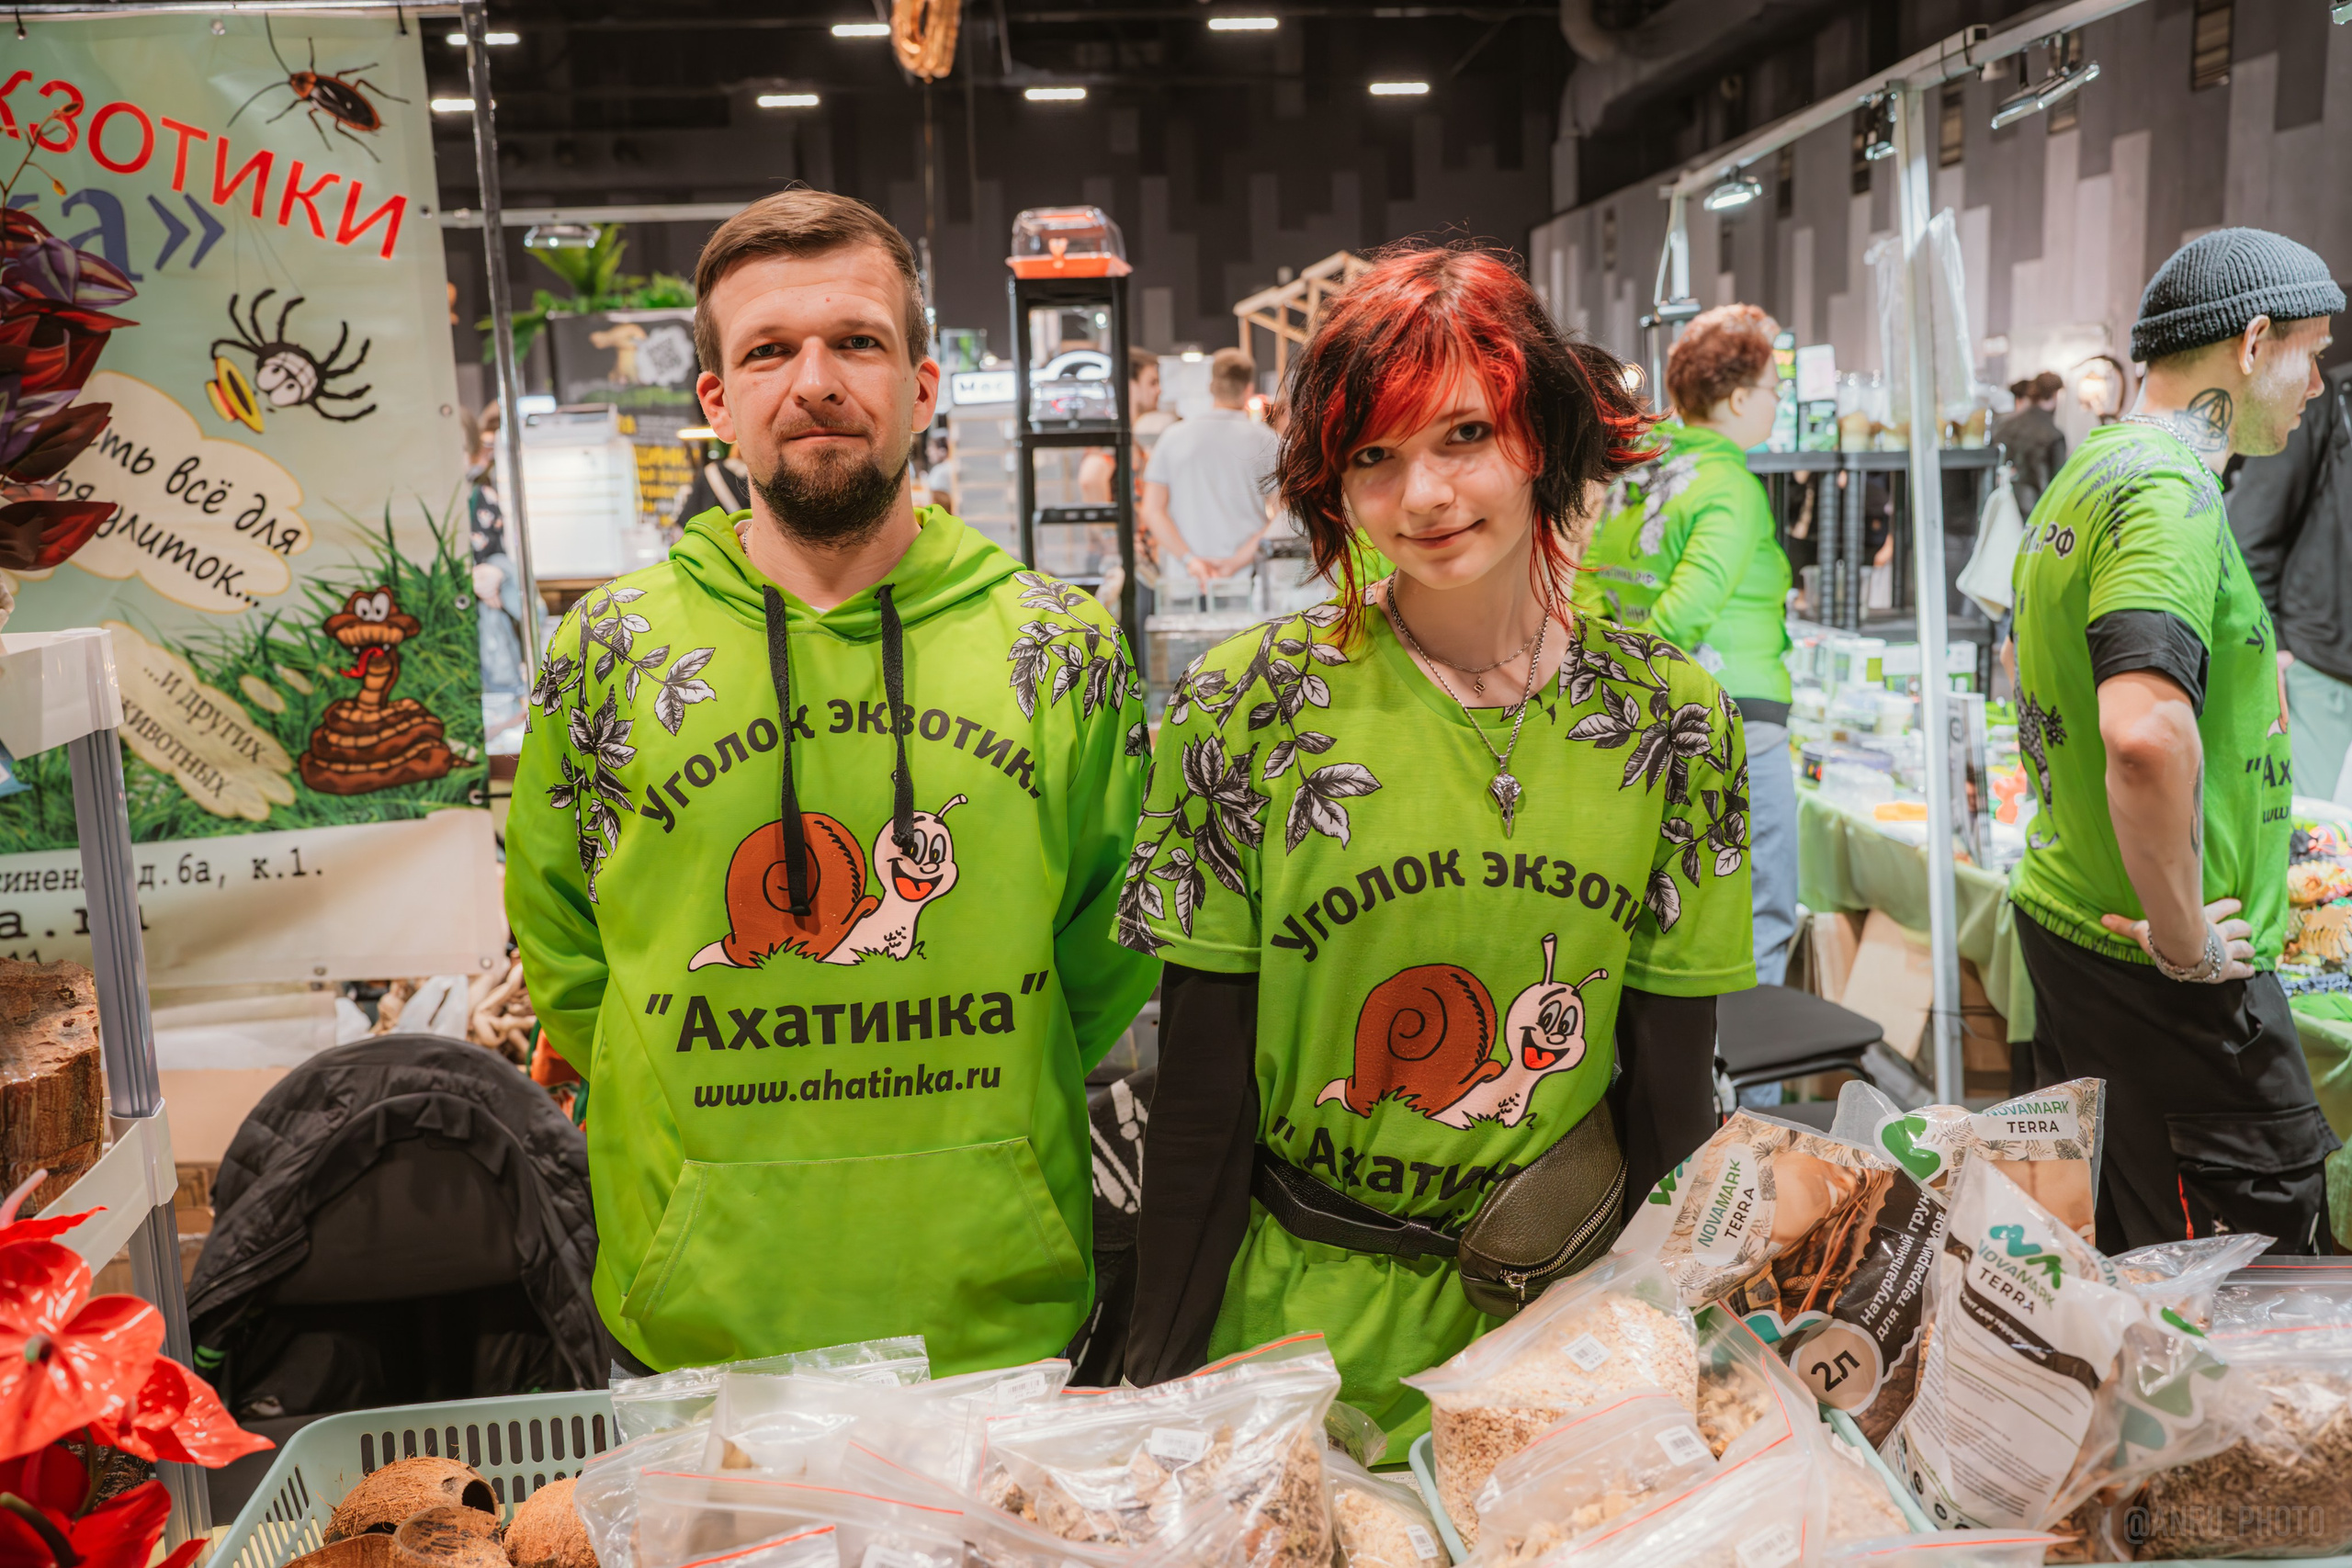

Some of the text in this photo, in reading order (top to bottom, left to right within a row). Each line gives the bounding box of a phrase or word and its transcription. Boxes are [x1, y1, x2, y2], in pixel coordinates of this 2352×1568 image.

[5, 187, 226, 283] а»
[165, 456, 232, 514] всё
[233, 492, 301, 555] для
[175, 687, 268, 764] других
[639, 707, 815, 833] Уголок
[252, 847, 323, 880] к.1.
[1271, 848, 1465, 963] Уголок
[645, 969, 1049, 1054] "Ахатинка"
[694, 1064, 1001, 1109] www.ahatinka.ru
[2007, 1120, 2060, 1134] TERRA
[1697, 1157, 1741, 1248] NOVAMARK
[1724, 1187, 1755, 1239] TERRA
[1860, 1190, 1931, 1326] Натуральный грун
[1981, 1266, 2036, 1315] TERRA
[1876, 1307, 1901, 1341] для
[1810, 1349, 1861, 1393] 2л
